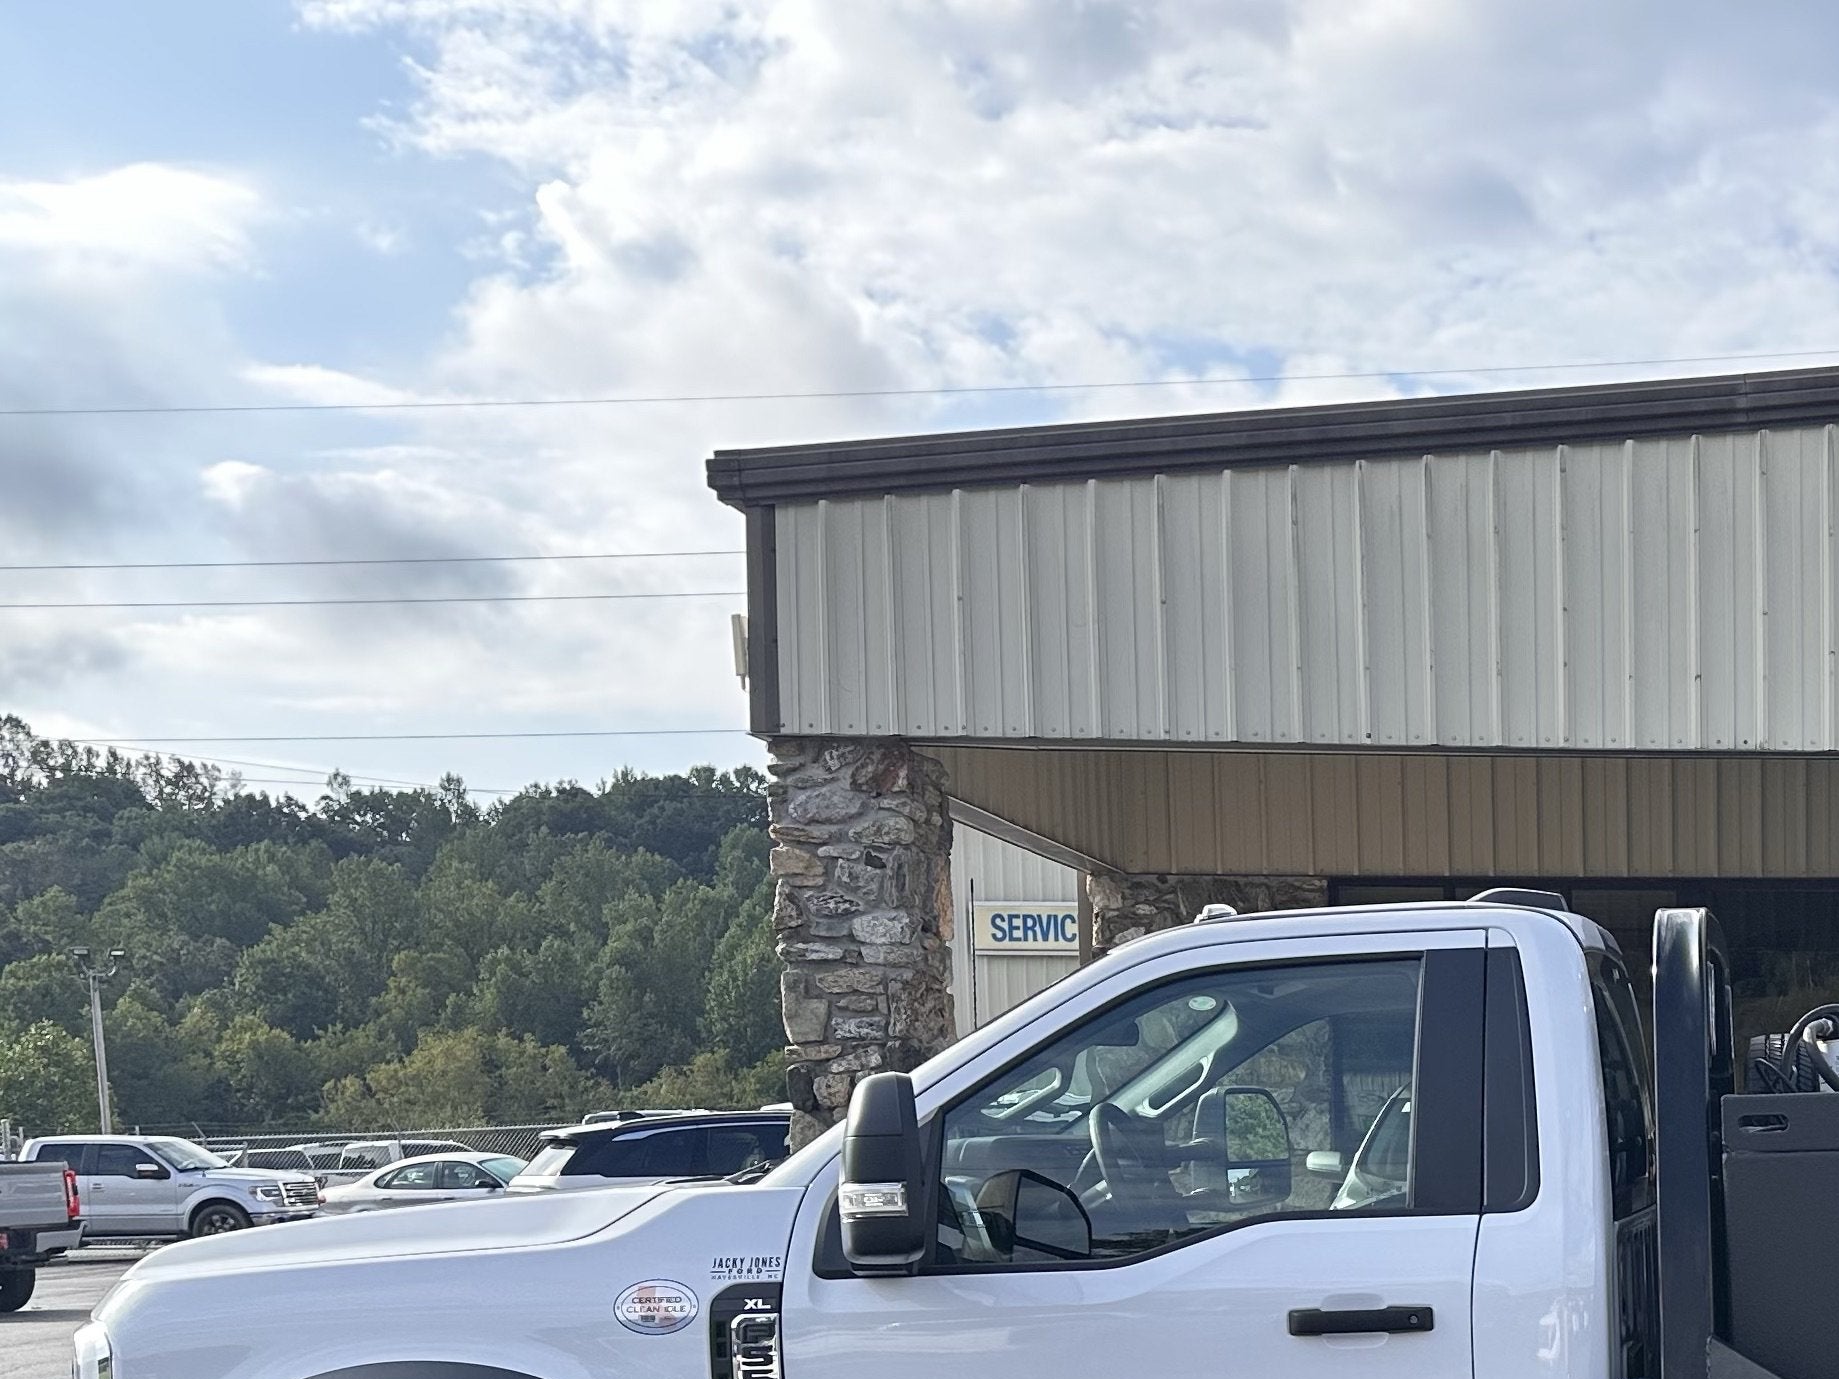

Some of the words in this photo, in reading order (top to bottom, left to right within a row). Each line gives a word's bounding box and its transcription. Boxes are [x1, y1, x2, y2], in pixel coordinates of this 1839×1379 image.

[990, 913, 1077, 943] SERVIC
[712, 1257, 745, 1269] JACKY
[750, 1256, 781, 1268] JONES
[728, 1267, 763, 1275] FORD
[631, 1296, 682, 1304] CERTIFIED
[743, 1298, 771, 1310] XL
[626, 1305, 660, 1313] CLEAN
